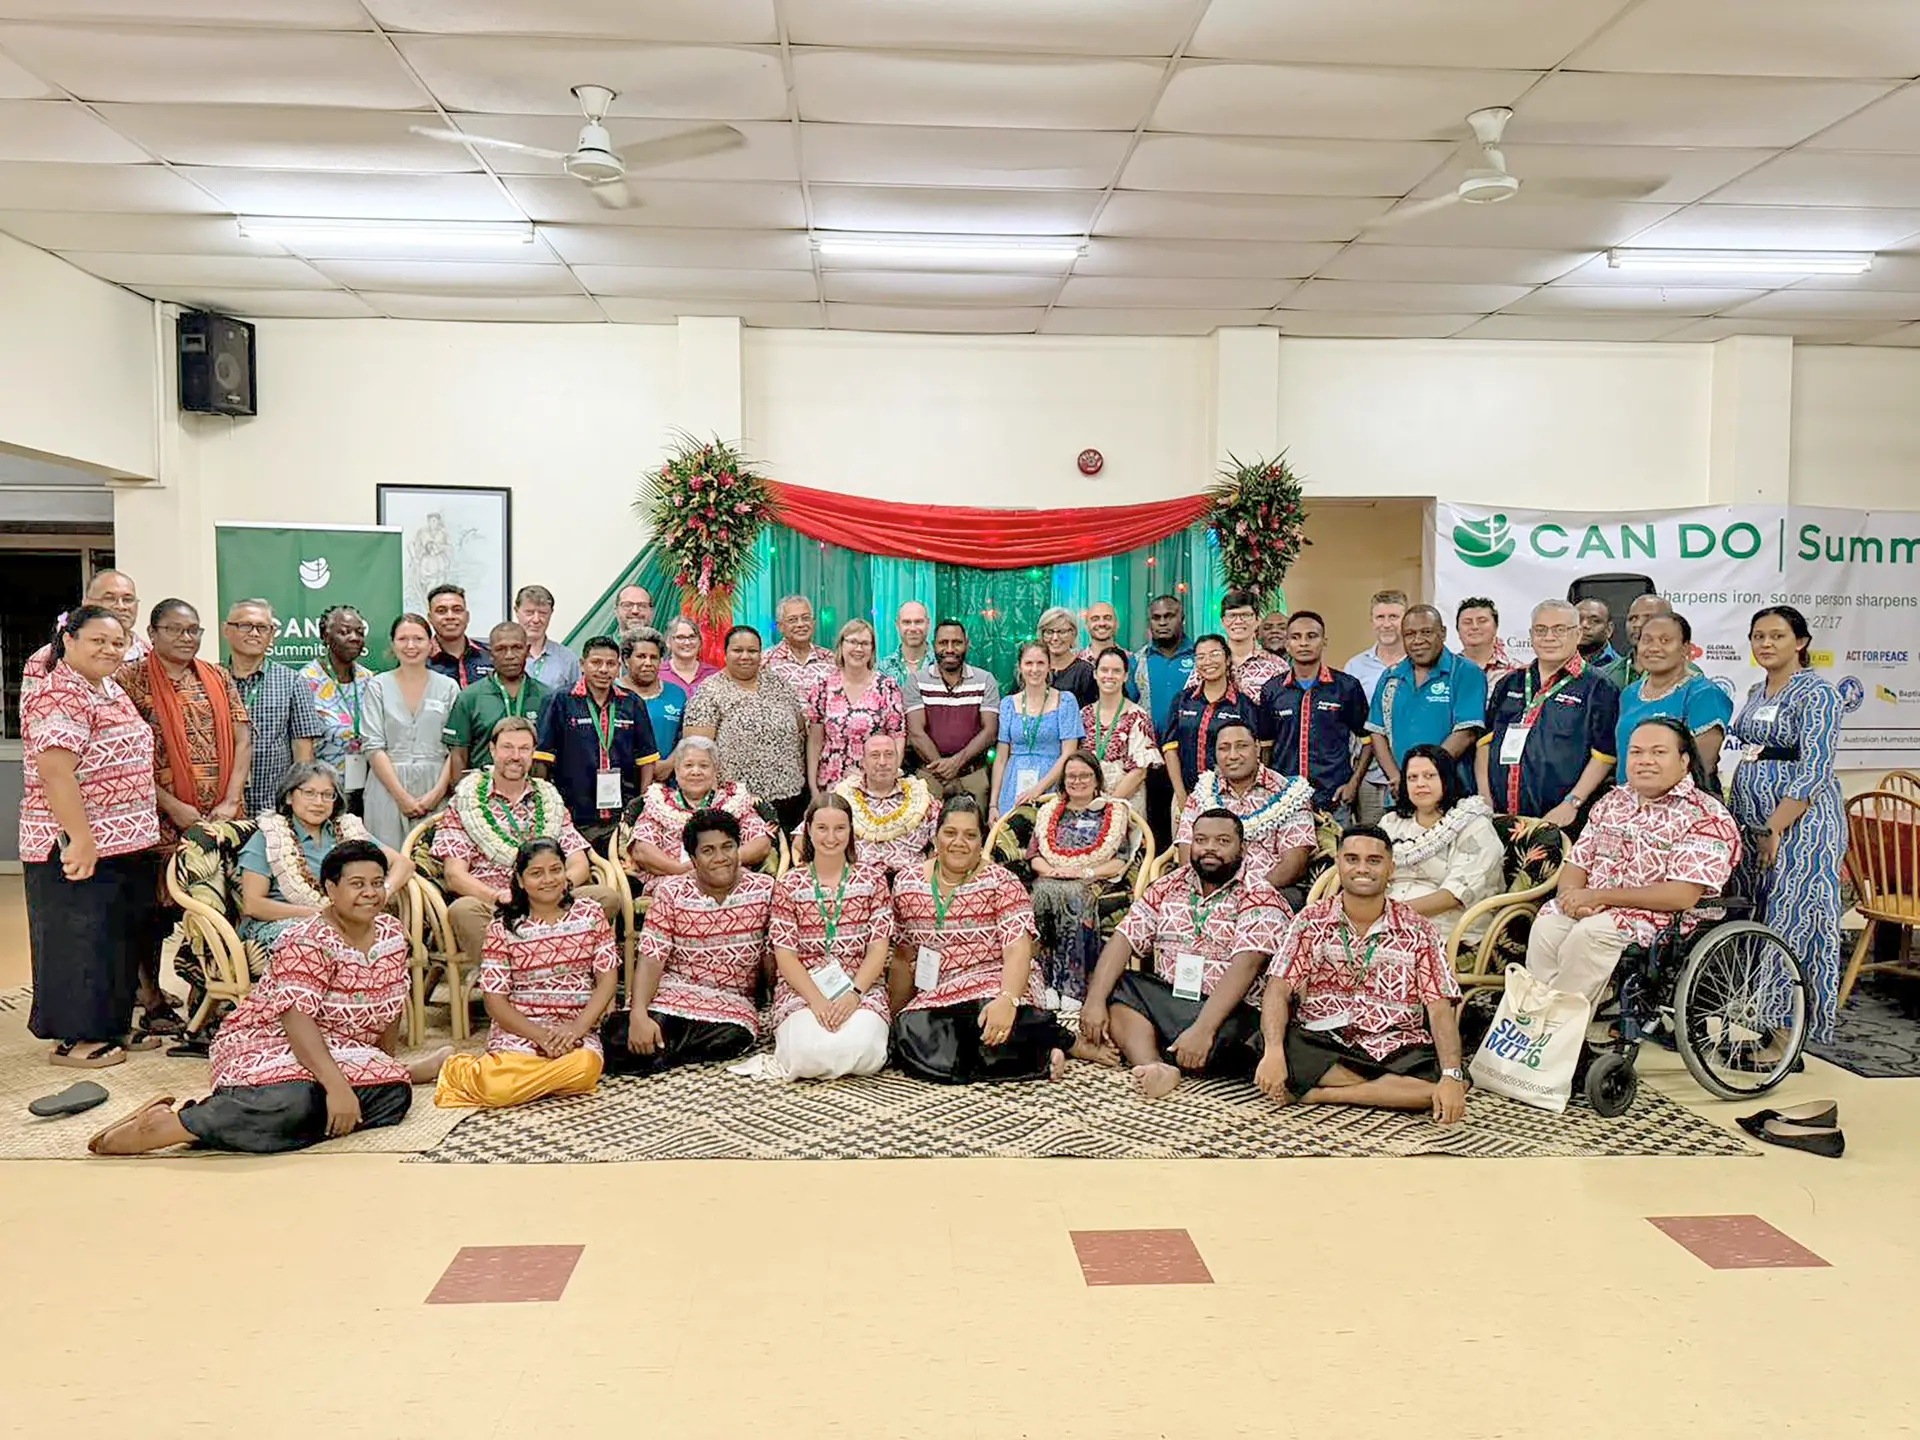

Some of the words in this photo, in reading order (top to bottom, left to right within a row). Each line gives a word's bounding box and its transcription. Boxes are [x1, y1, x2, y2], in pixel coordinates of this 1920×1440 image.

[1529, 523, 1657, 559] CAN
[1678, 522, 1762, 559] DO
[1733, 590, 1765, 605] iron,
[1770, 592, 1788, 604] so
[1790, 593, 1811, 605] one
[1815, 594, 1852, 607] person
[1856, 592, 1918, 608] sharpens
[1507, 636, 1532, 648] Cari
[264, 643, 326, 657] Summit
[1845, 651, 1861, 661] ACT
[1862, 651, 1879, 661] FOR
[1880, 651, 1909, 662] PEACE
[1842, 735, 1878, 743] Australian
